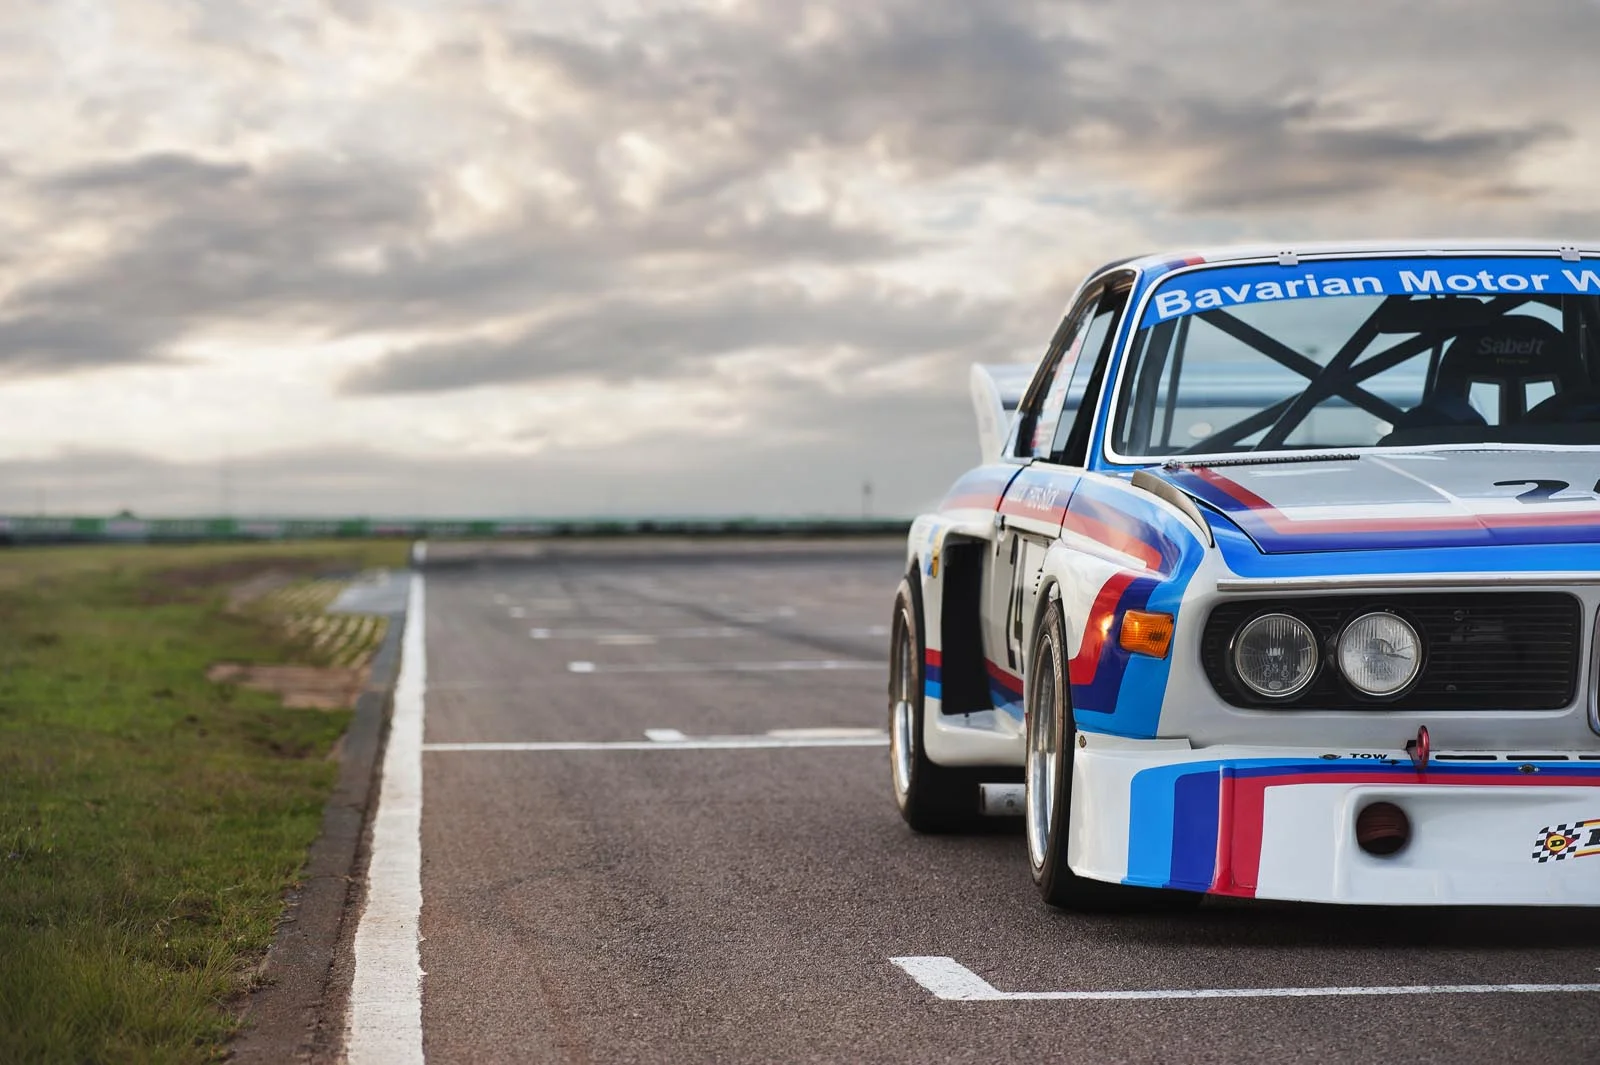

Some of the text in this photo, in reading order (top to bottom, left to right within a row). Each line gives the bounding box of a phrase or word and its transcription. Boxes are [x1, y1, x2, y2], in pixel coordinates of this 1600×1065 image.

[1155, 274, 1384, 320] Bavarian
[1399, 270, 1549, 293] Motor
[1477, 336, 1545, 355] Sabelt
